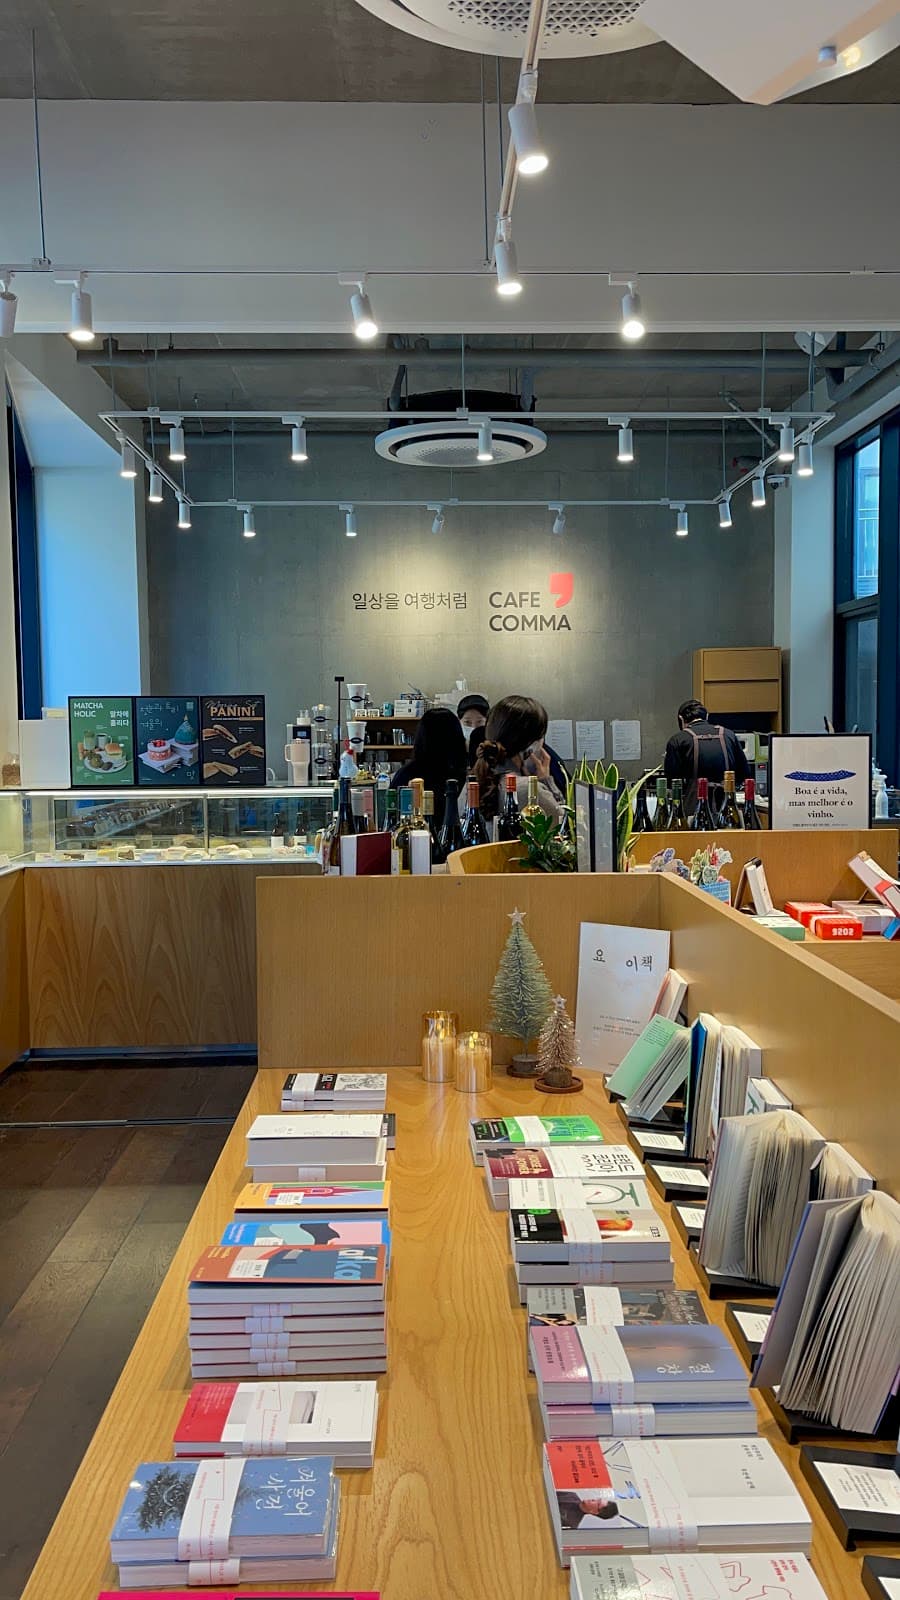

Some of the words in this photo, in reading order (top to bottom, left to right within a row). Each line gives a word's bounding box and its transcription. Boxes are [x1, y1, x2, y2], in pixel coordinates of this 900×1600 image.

[352, 592, 400, 609] 일상을
[404, 592, 467, 609] 여행처럼
[489, 591, 540, 608] CAFE
[489, 614, 571, 631] COMMA
[74, 710, 96, 718] HOLIC
[210, 706, 257, 717] PANINI
[795, 787, 811, 795] Boa
[827, 787, 847, 796] vida,
[808, 799, 839, 807] melhor
[808, 810, 834, 818] vinho.
[593, 948, 606, 962] 요
[591, 1153, 617, 1173] 코리아
[611, 1154, 635, 1172] 트렌드
[283, 1466, 317, 1516] 겨울어
